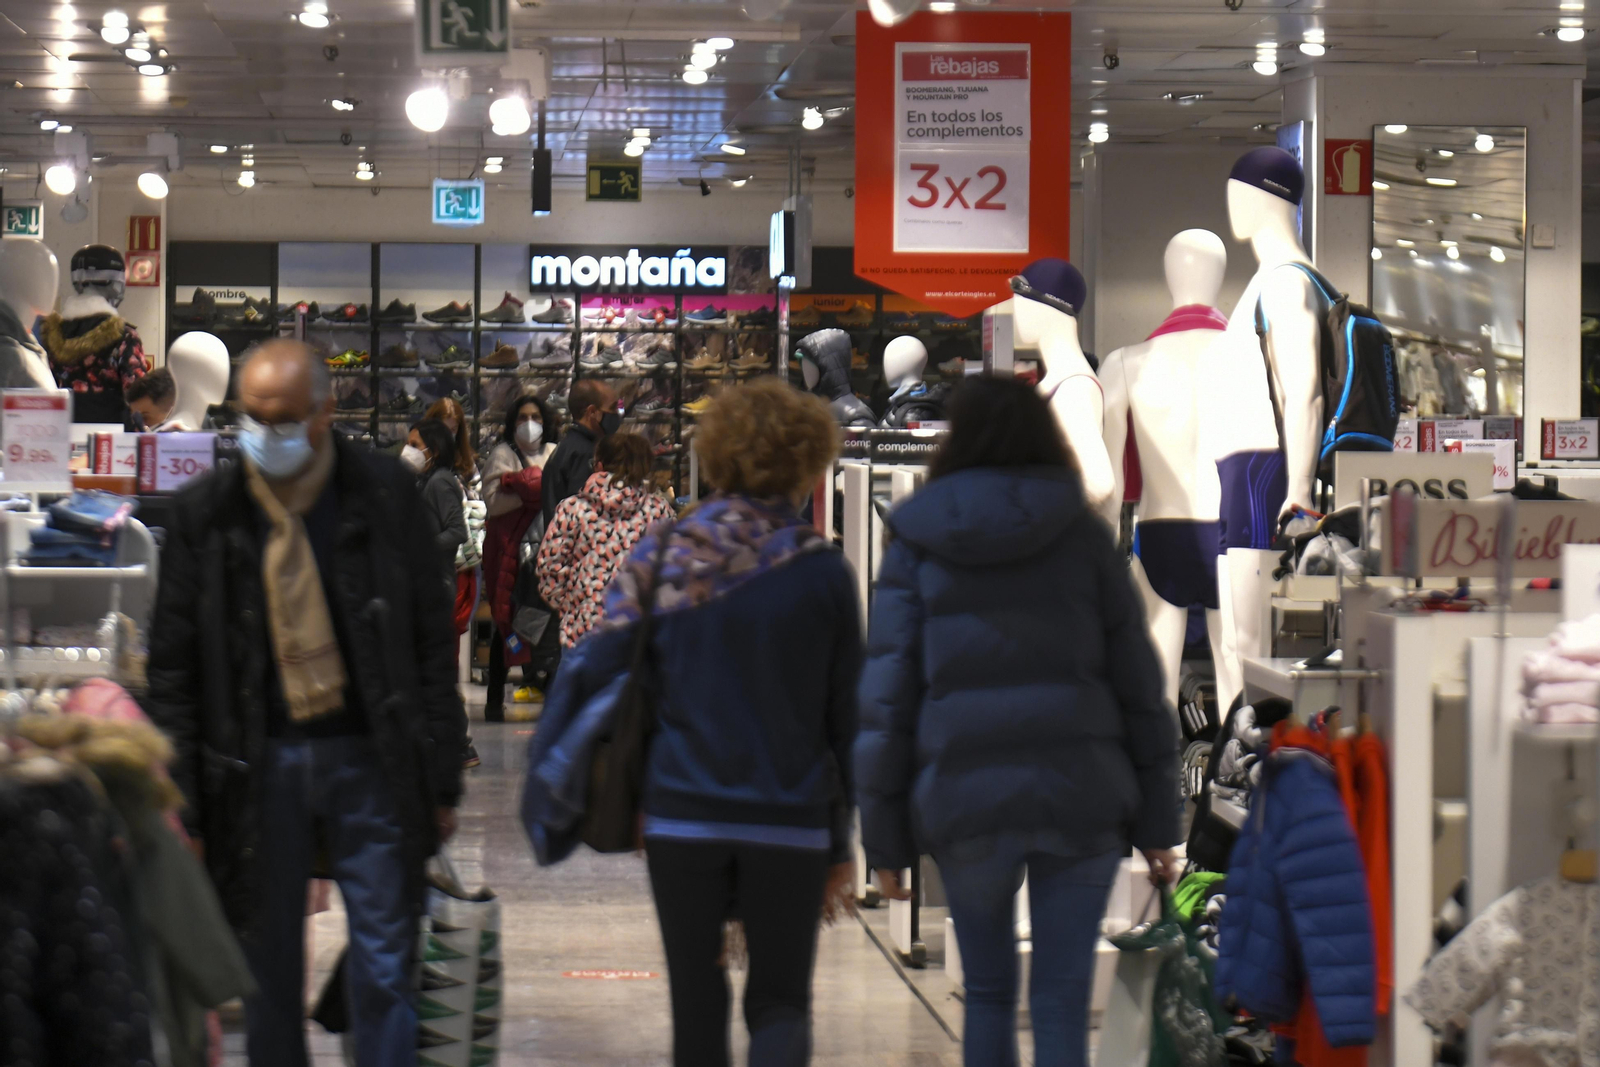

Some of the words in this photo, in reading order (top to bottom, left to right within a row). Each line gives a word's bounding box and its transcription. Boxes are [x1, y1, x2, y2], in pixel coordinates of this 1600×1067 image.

[930, 57, 1000, 78] rebajas
[905, 86, 956, 94] BOOMERANG,
[907, 110, 926, 123] En
[931, 109, 976, 122] todos
[981, 108, 1003, 122] los
[907, 123, 1024, 139] complementos
[906, 162, 1008, 211] 3x2
[531, 248, 726, 287] montaña
[204, 288, 246, 299] ombre
[925, 290, 996, 298] www.elcorteingles.es
